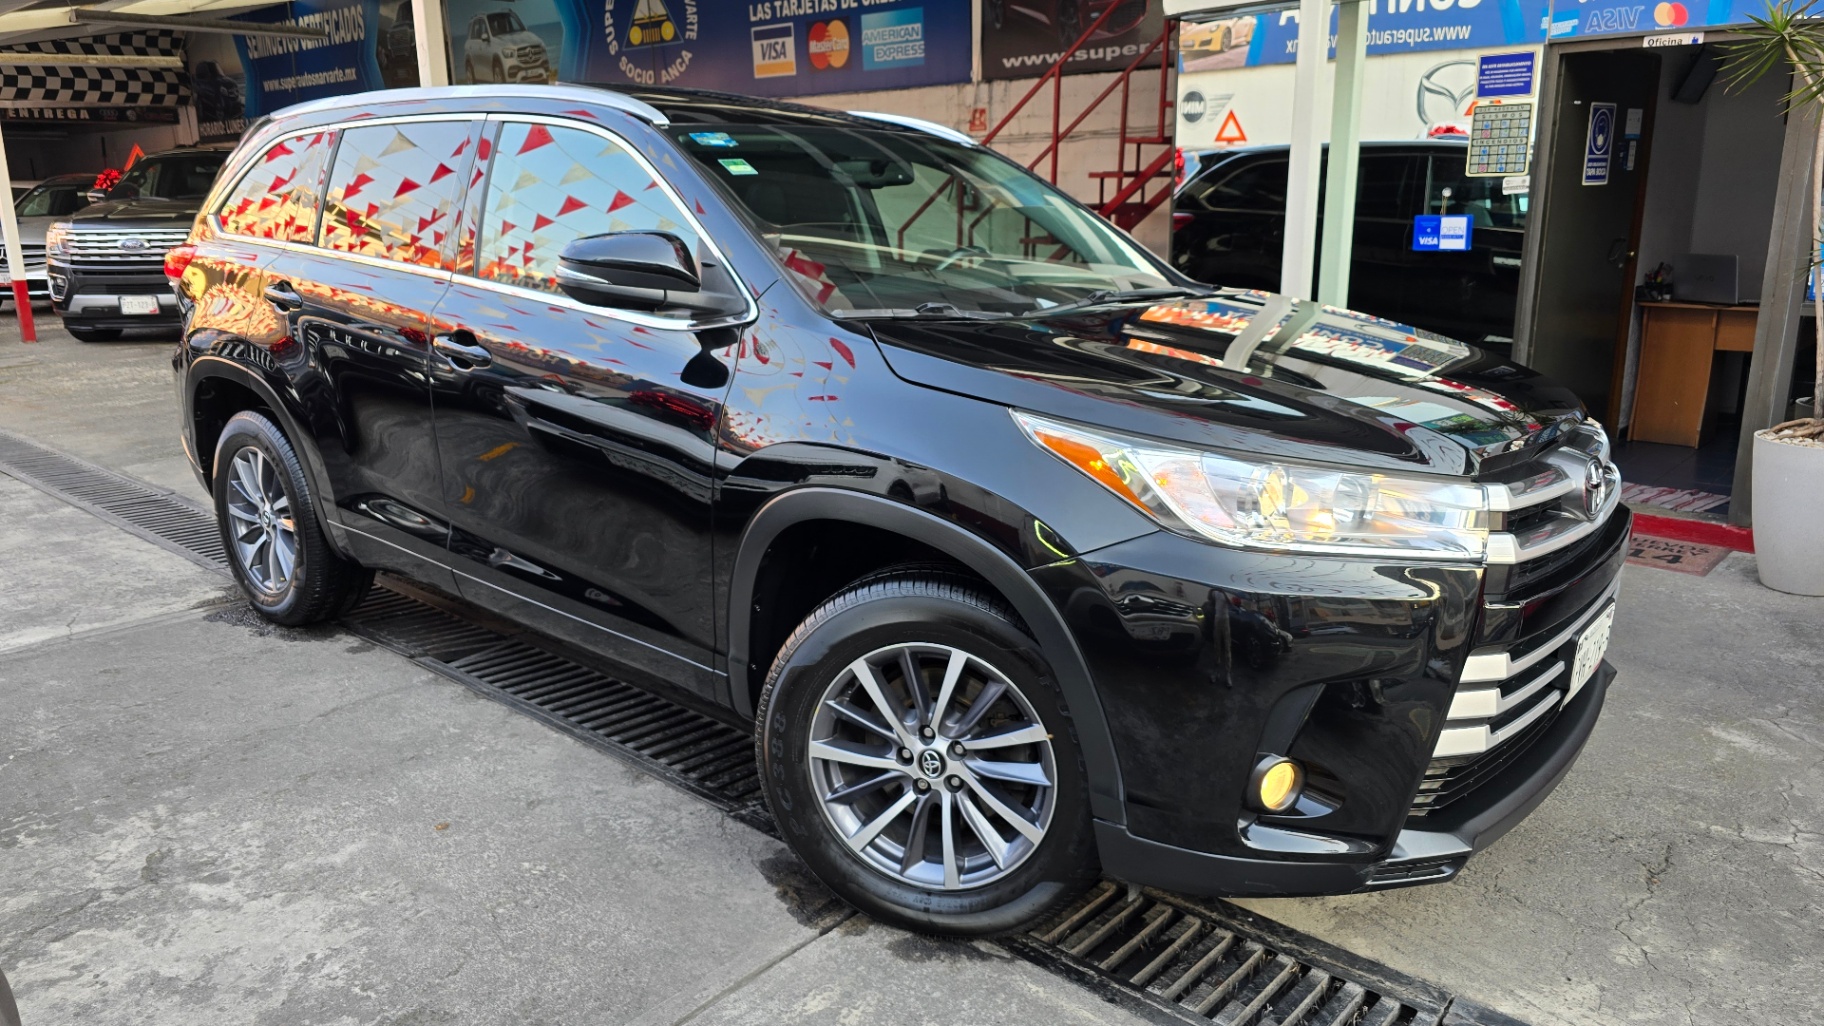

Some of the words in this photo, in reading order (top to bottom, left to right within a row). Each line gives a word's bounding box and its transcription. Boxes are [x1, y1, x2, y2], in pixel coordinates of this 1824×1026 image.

[749, 3, 772, 22] LAS
[776, 0, 838, 18] TARJETAS
[298, 4, 365, 52] CERTIFICADOS
[863, 25, 921, 45] AMERICAN
[760, 41, 787, 61] VISA
[1647, 37, 1683, 47] Oficina
[875, 43, 925, 61] EXPRESS
[619, 56, 655, 84] SOCIO
[661, 50, 693, 83] ANCA
[8, 107, 90, 121] ENTREGA
[1442, 226, 1465, 234] OPEN
[1418, 236, 1439, 245] VISA
